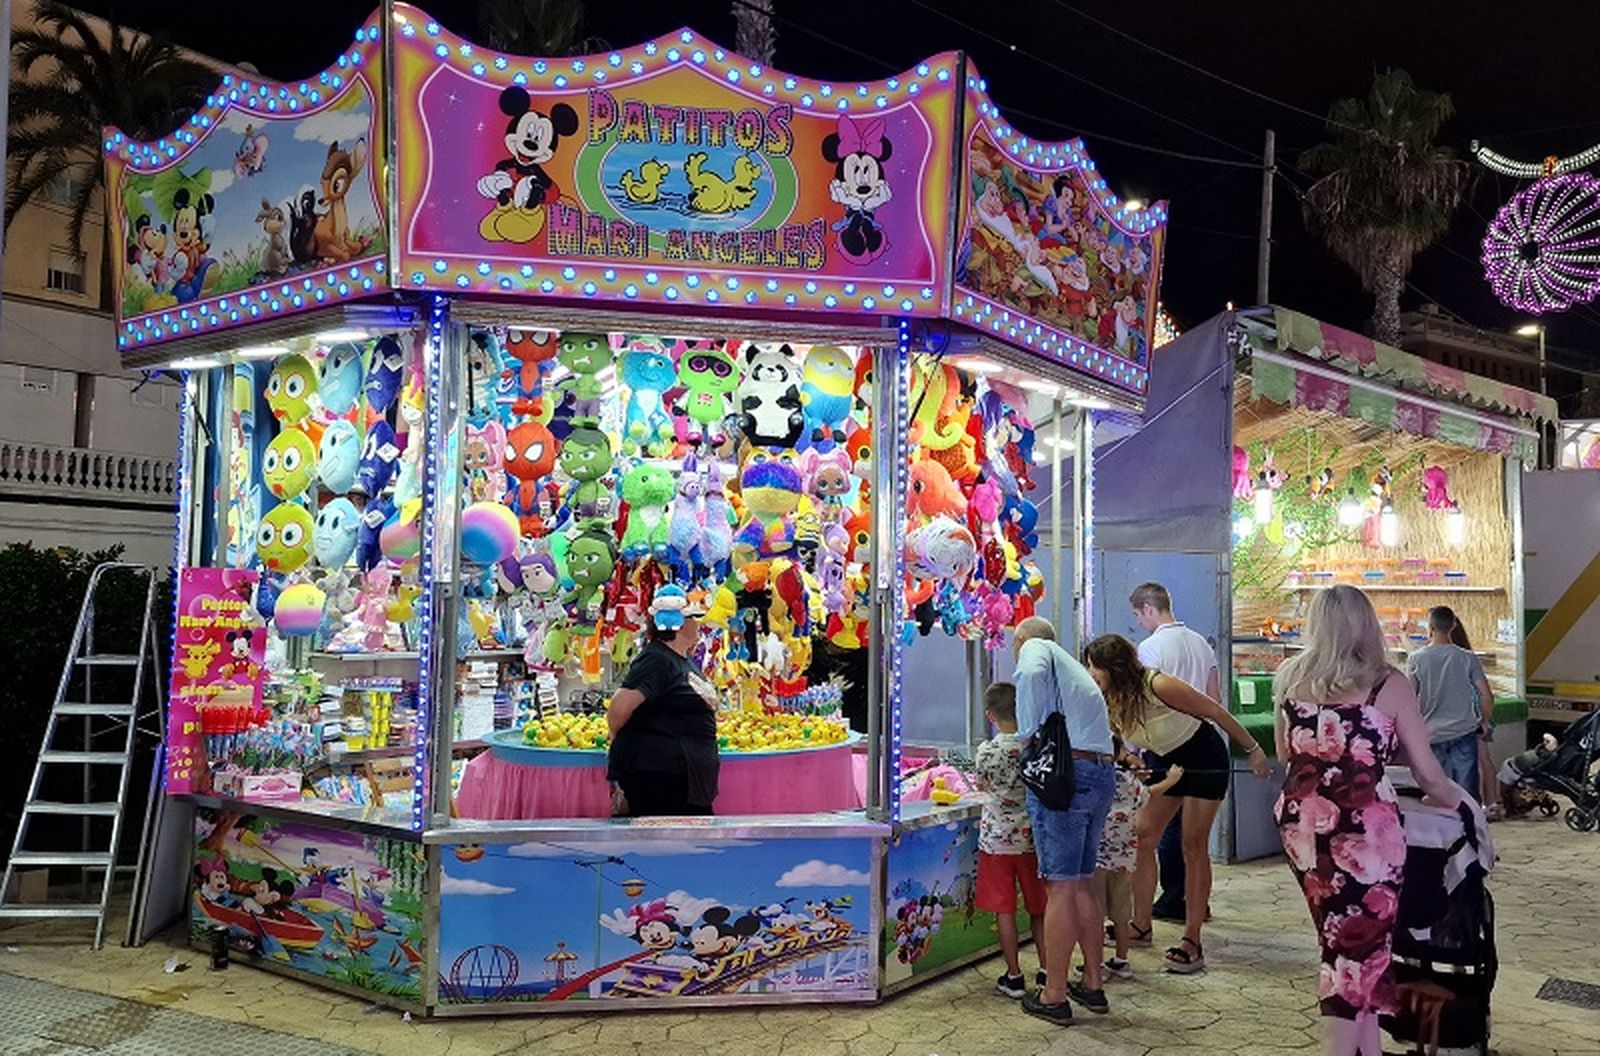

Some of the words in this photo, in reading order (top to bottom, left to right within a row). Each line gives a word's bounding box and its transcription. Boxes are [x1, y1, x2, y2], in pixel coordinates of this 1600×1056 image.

[588, 89, 793, 157] PATITOS
[547, 202, 650, 258] MARI
[664, 217, 826, 270] ANGELES
